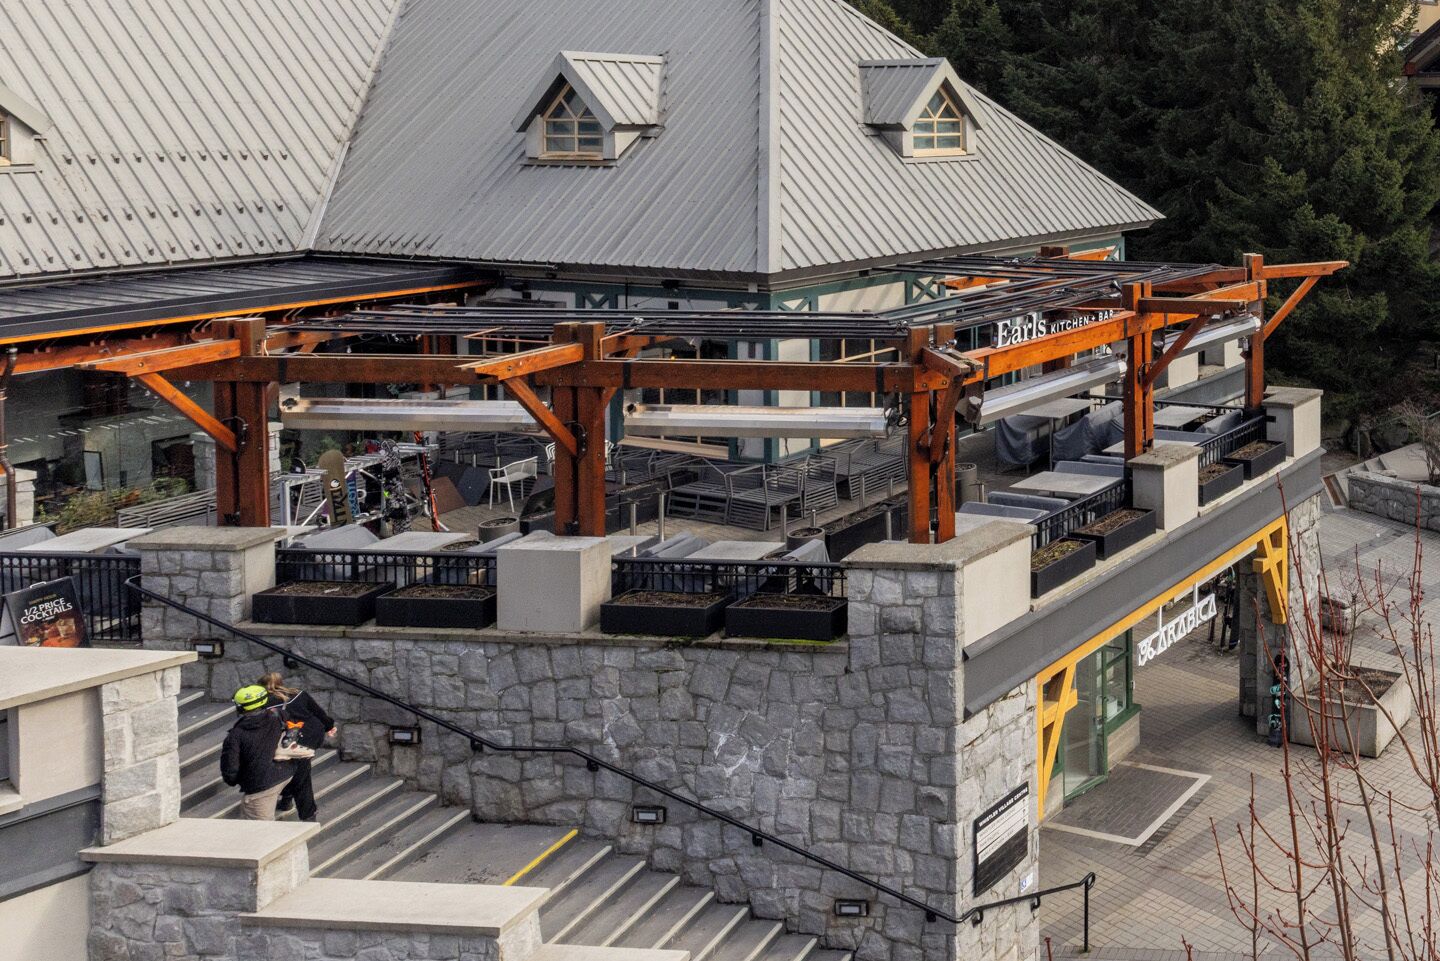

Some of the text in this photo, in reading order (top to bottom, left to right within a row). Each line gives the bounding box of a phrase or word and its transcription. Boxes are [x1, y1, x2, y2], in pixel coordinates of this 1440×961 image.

[996, 312, 1046, 348] Earls
[1050, 316, 1089, 334] KITCHEN
[1098, 310, 1114, 321] BAR
[20, 602, 73, 624] COCKTAILS
[24, 597, 66, 616] 1/2 PRICE
[1156, 593, 1217, 655] ARABICA
[998, 797, 1014, 812] VILLAGE
